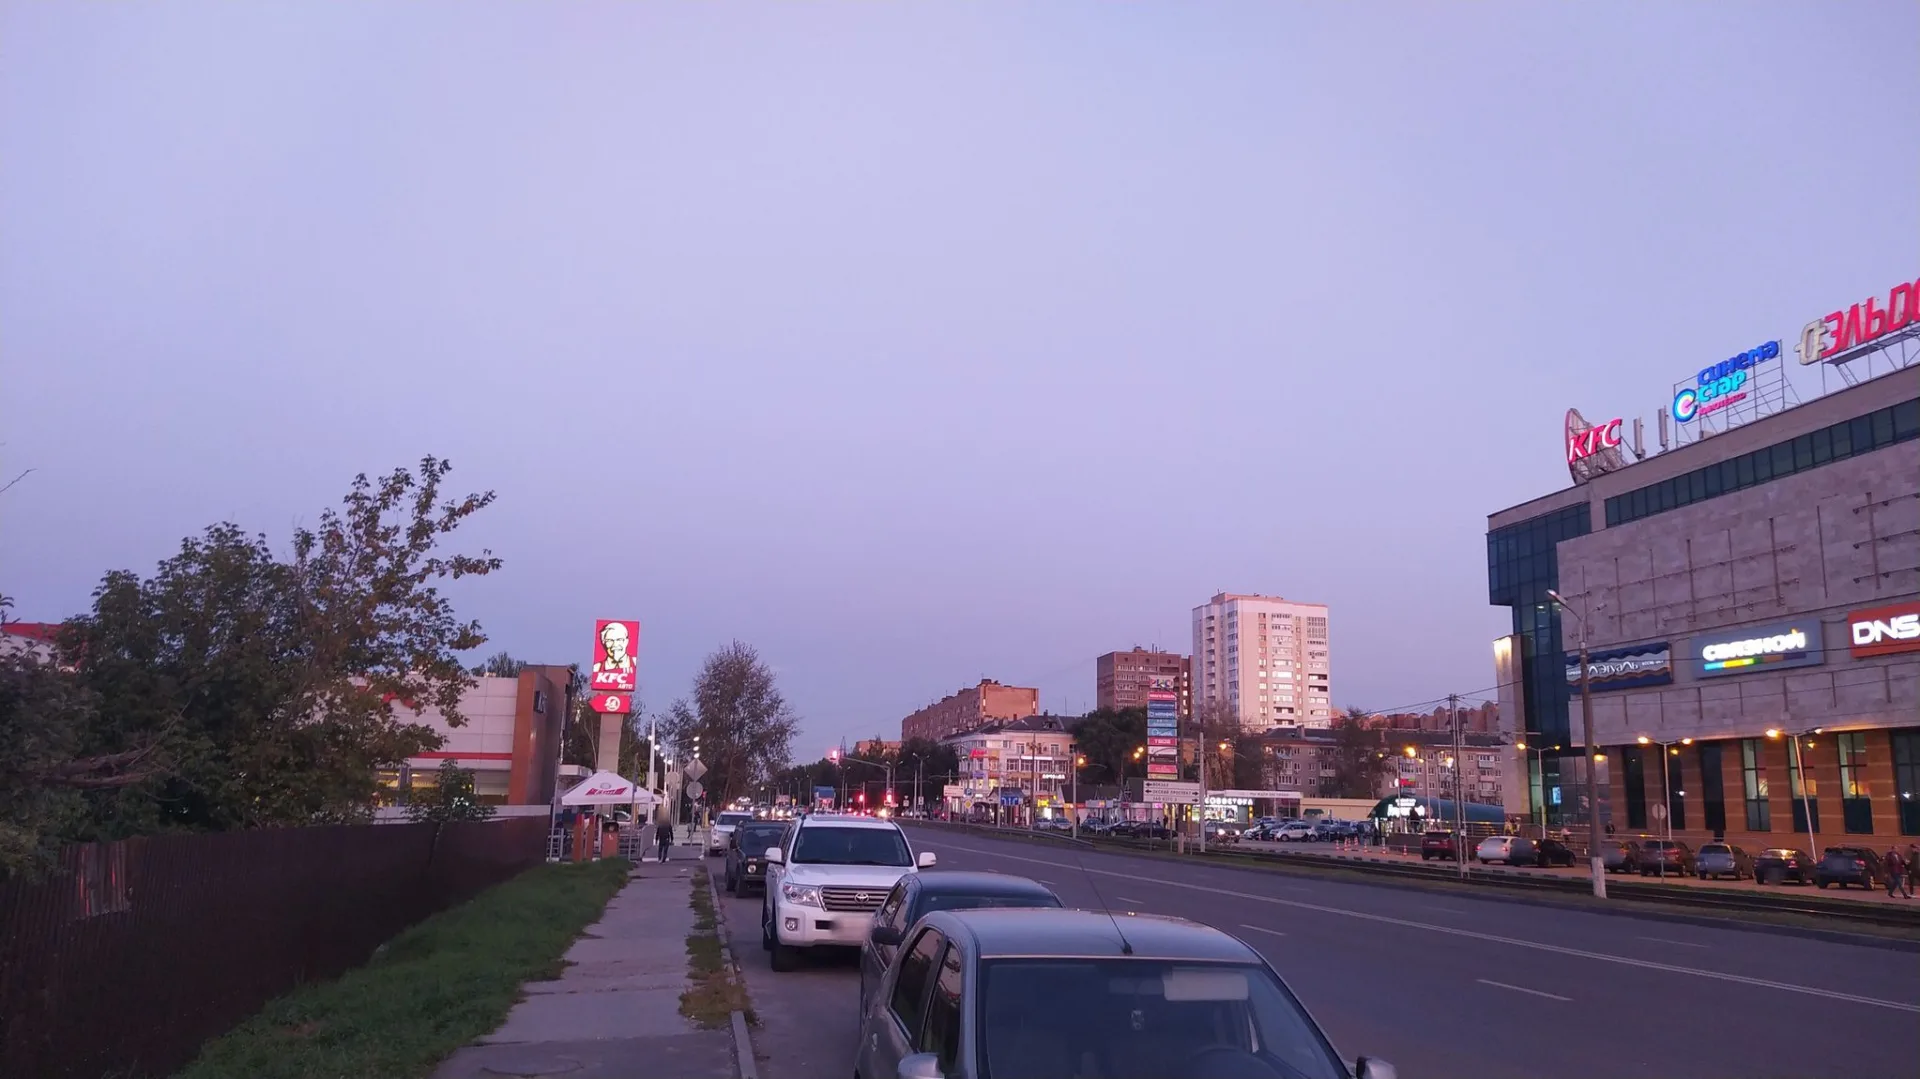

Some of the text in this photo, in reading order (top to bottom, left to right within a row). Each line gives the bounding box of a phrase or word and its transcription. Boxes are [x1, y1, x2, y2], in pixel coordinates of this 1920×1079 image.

[1569, 418, 1623, 463] KFC
[1852, 614, 1920, 645] DNS
[595, 672, 628, 684] KFC
